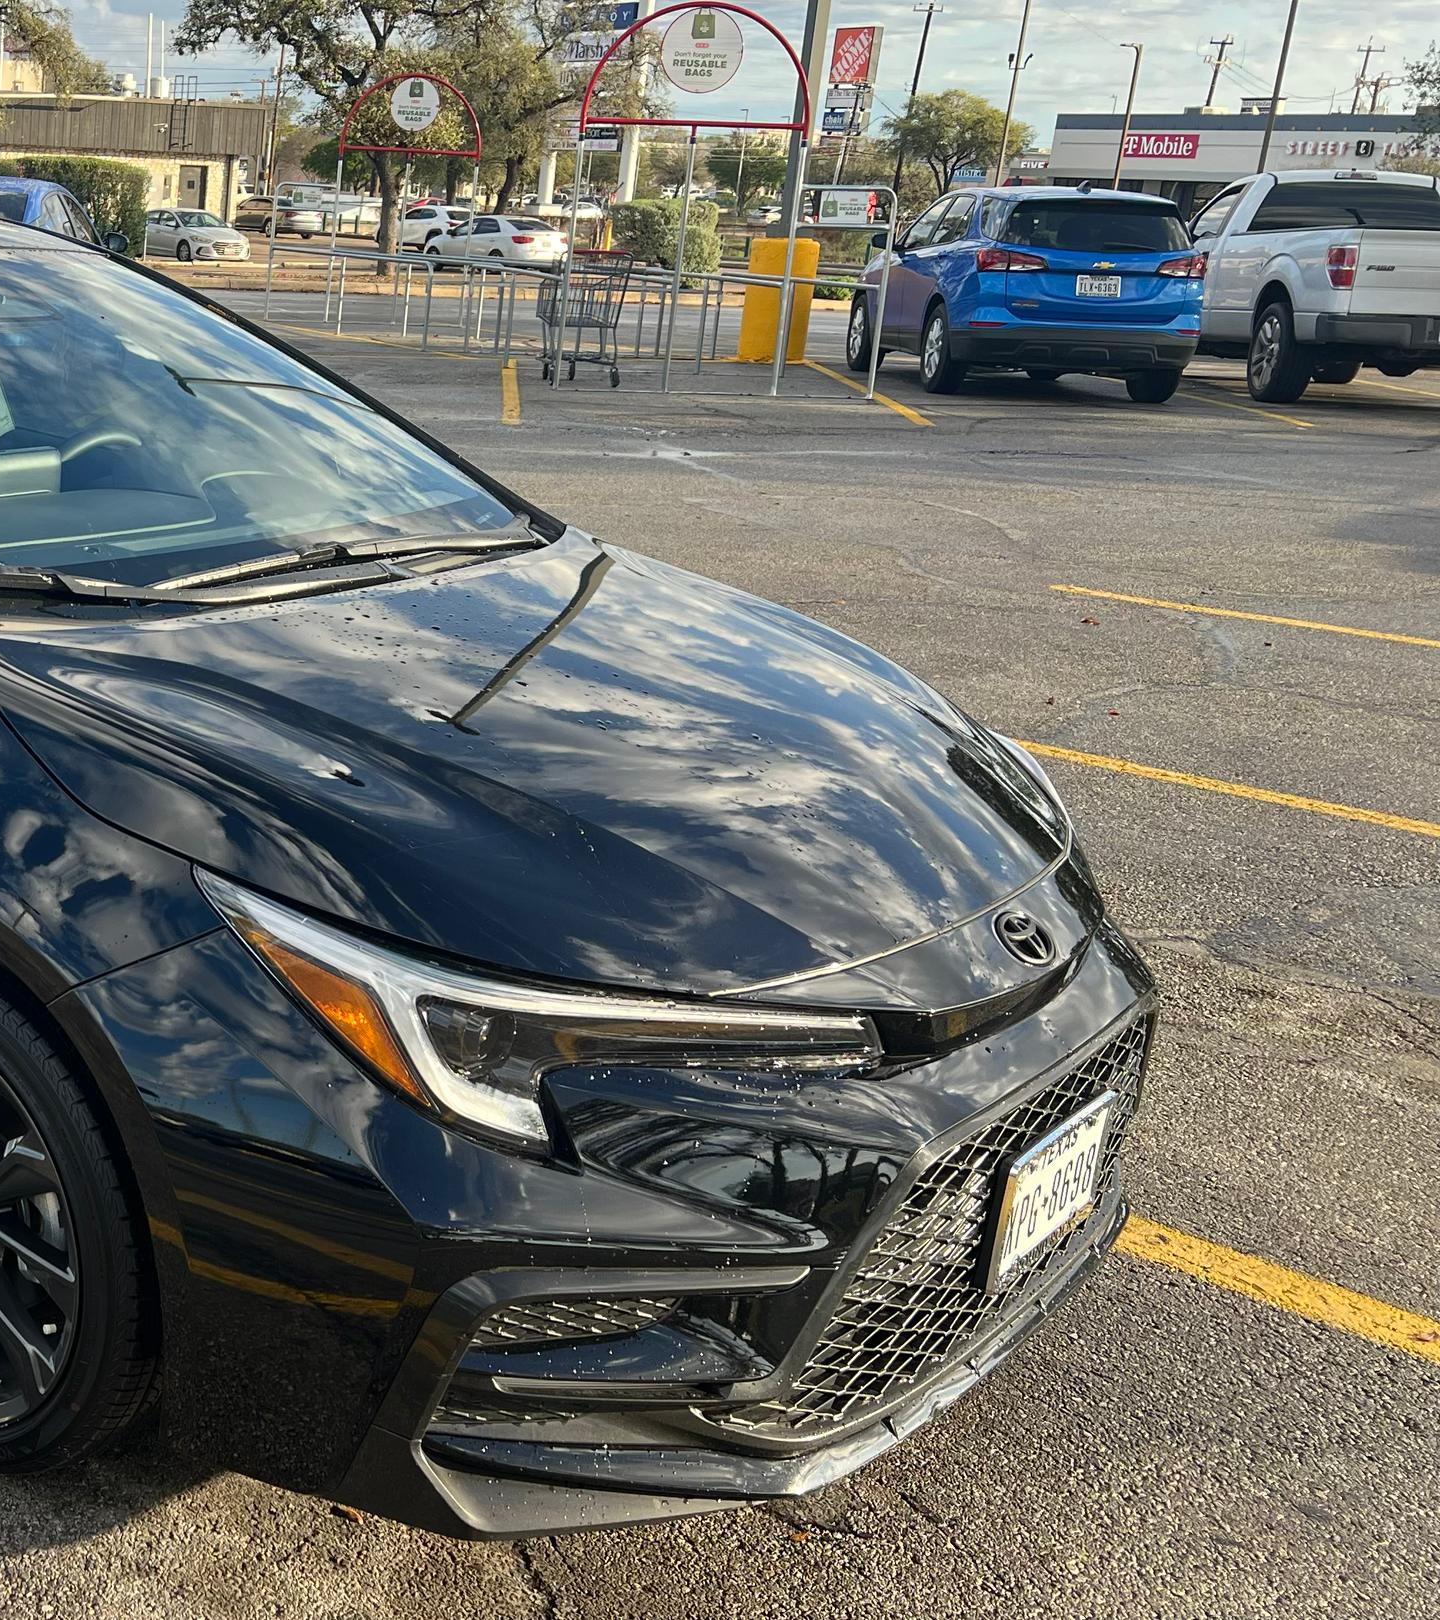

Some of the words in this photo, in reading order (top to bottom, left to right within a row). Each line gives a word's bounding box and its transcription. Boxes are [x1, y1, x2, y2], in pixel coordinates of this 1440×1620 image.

[839, 35, 855, 56] THE
[672, 59, 727, 68] REUSABLE
[831, 29, 872, 82] HOME
[844, 47, 870, 82] DEPOT
[685, 68, 712, 77] BAGS
[1285, 141, 1349, 156] STREET
[1020, 161, 1045, 169] FIVE
[1041, 1131, 1079, 1169] TEXAS
